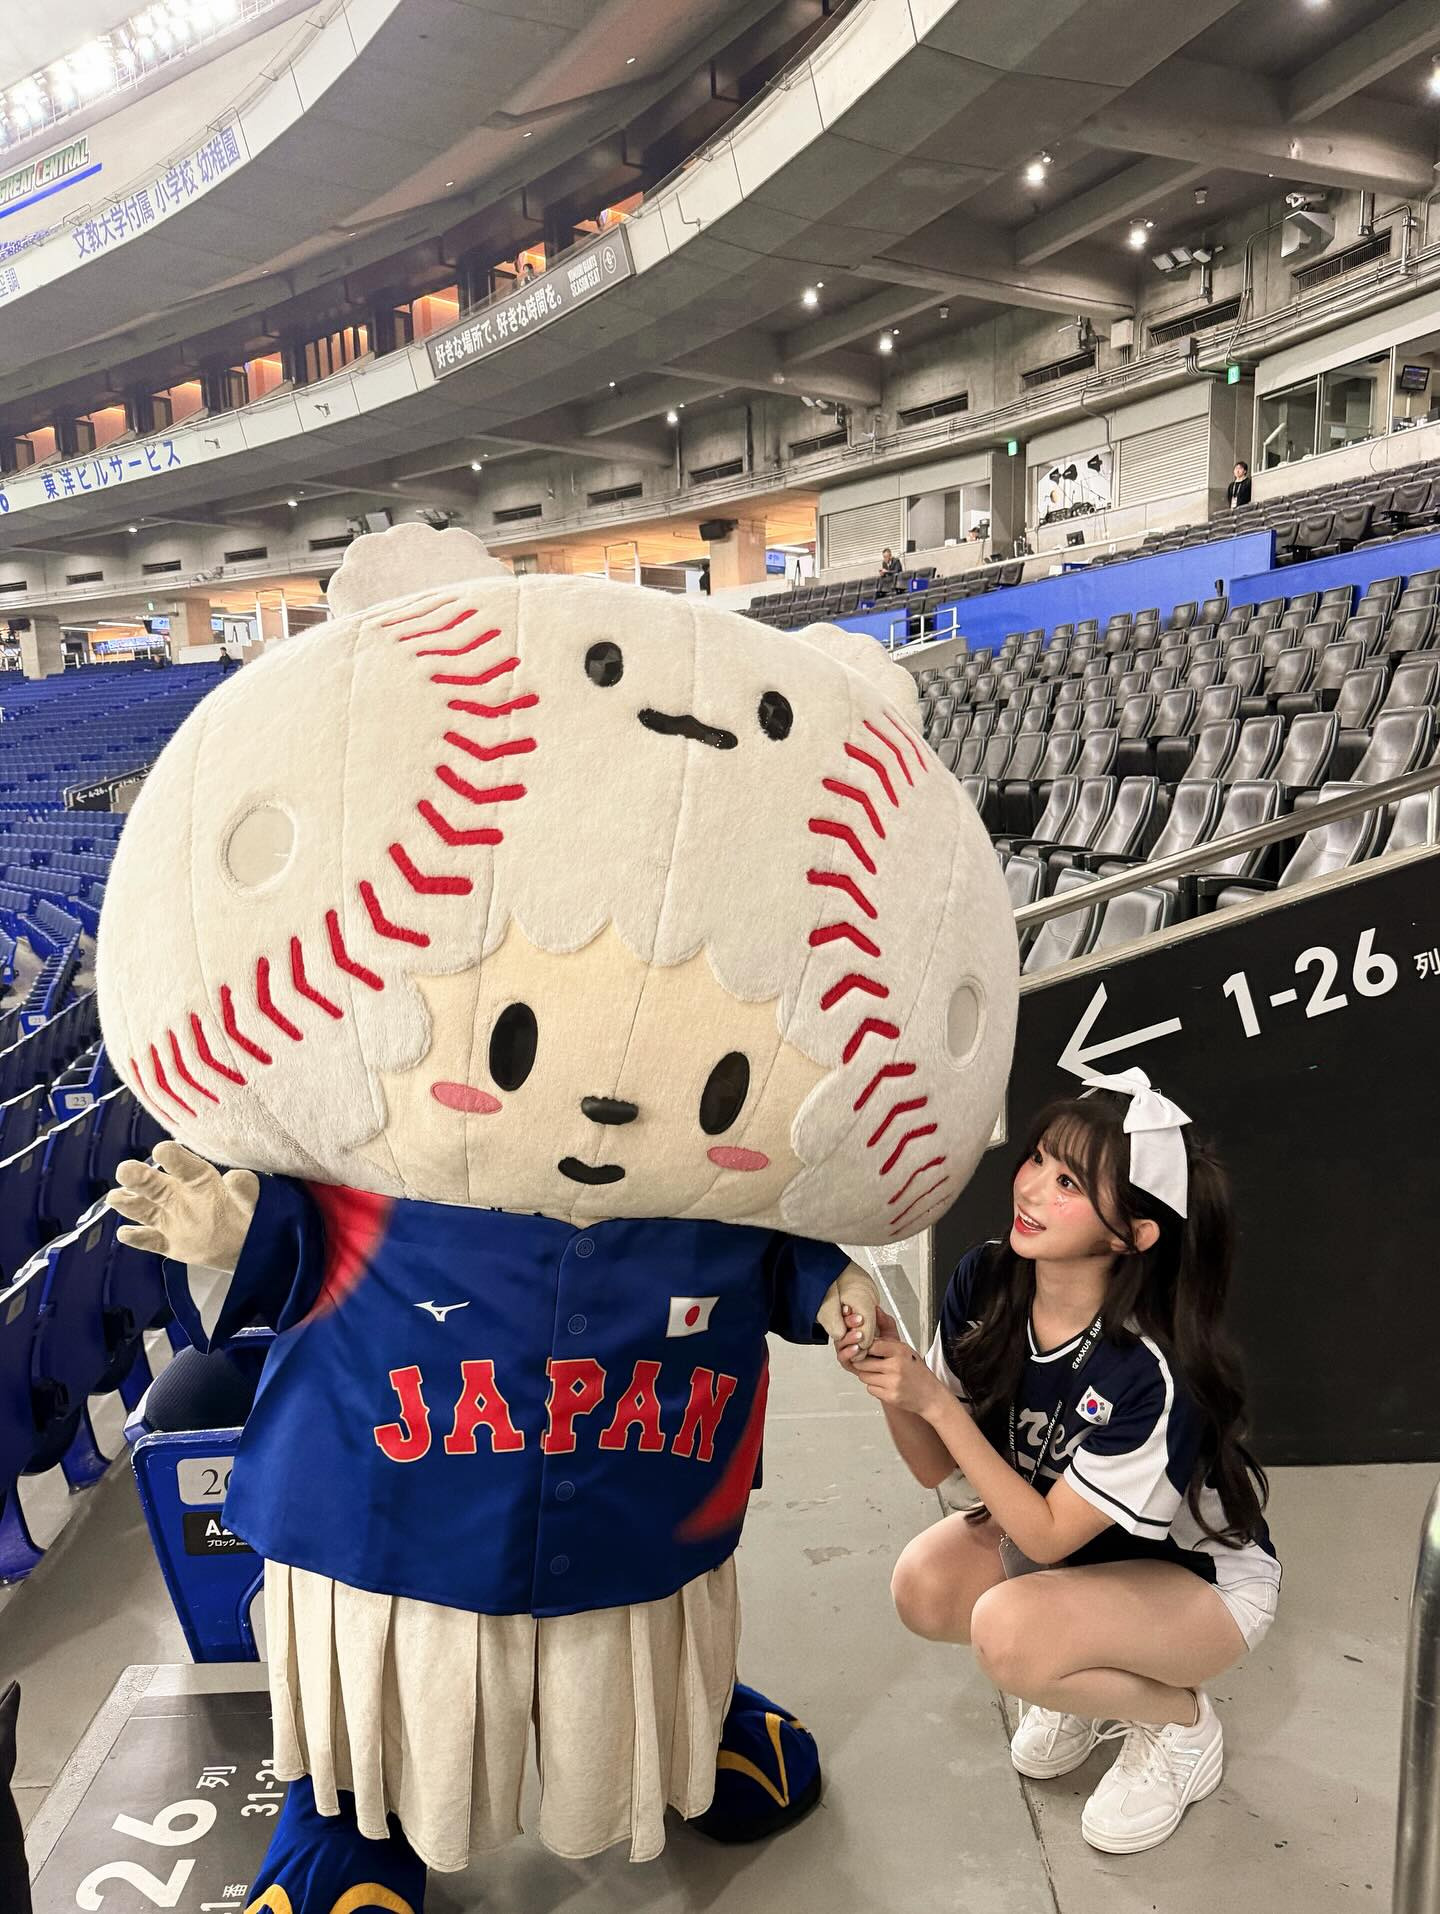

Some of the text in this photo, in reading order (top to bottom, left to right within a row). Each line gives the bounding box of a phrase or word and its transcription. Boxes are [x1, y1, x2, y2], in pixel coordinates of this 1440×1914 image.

[35, 137, 89, 188] CENTRAL
[72, 189, 155, 258] 文教大学付属
[155, 160, 199, 213] 小学校
[196, 126, 241, 183] 幼稚園
[435, 283, 562, 368] 好きな場所で、好きな時間を。
[41, 439, 181, 499] 東洋ビルサービス
[73, 1096, 87, 1106] 23
[374, 1357, 738, 1463] JAPAN
[201, 1468, 233, 1496] 2
[207, 1539, 236, 1547] ブロック
